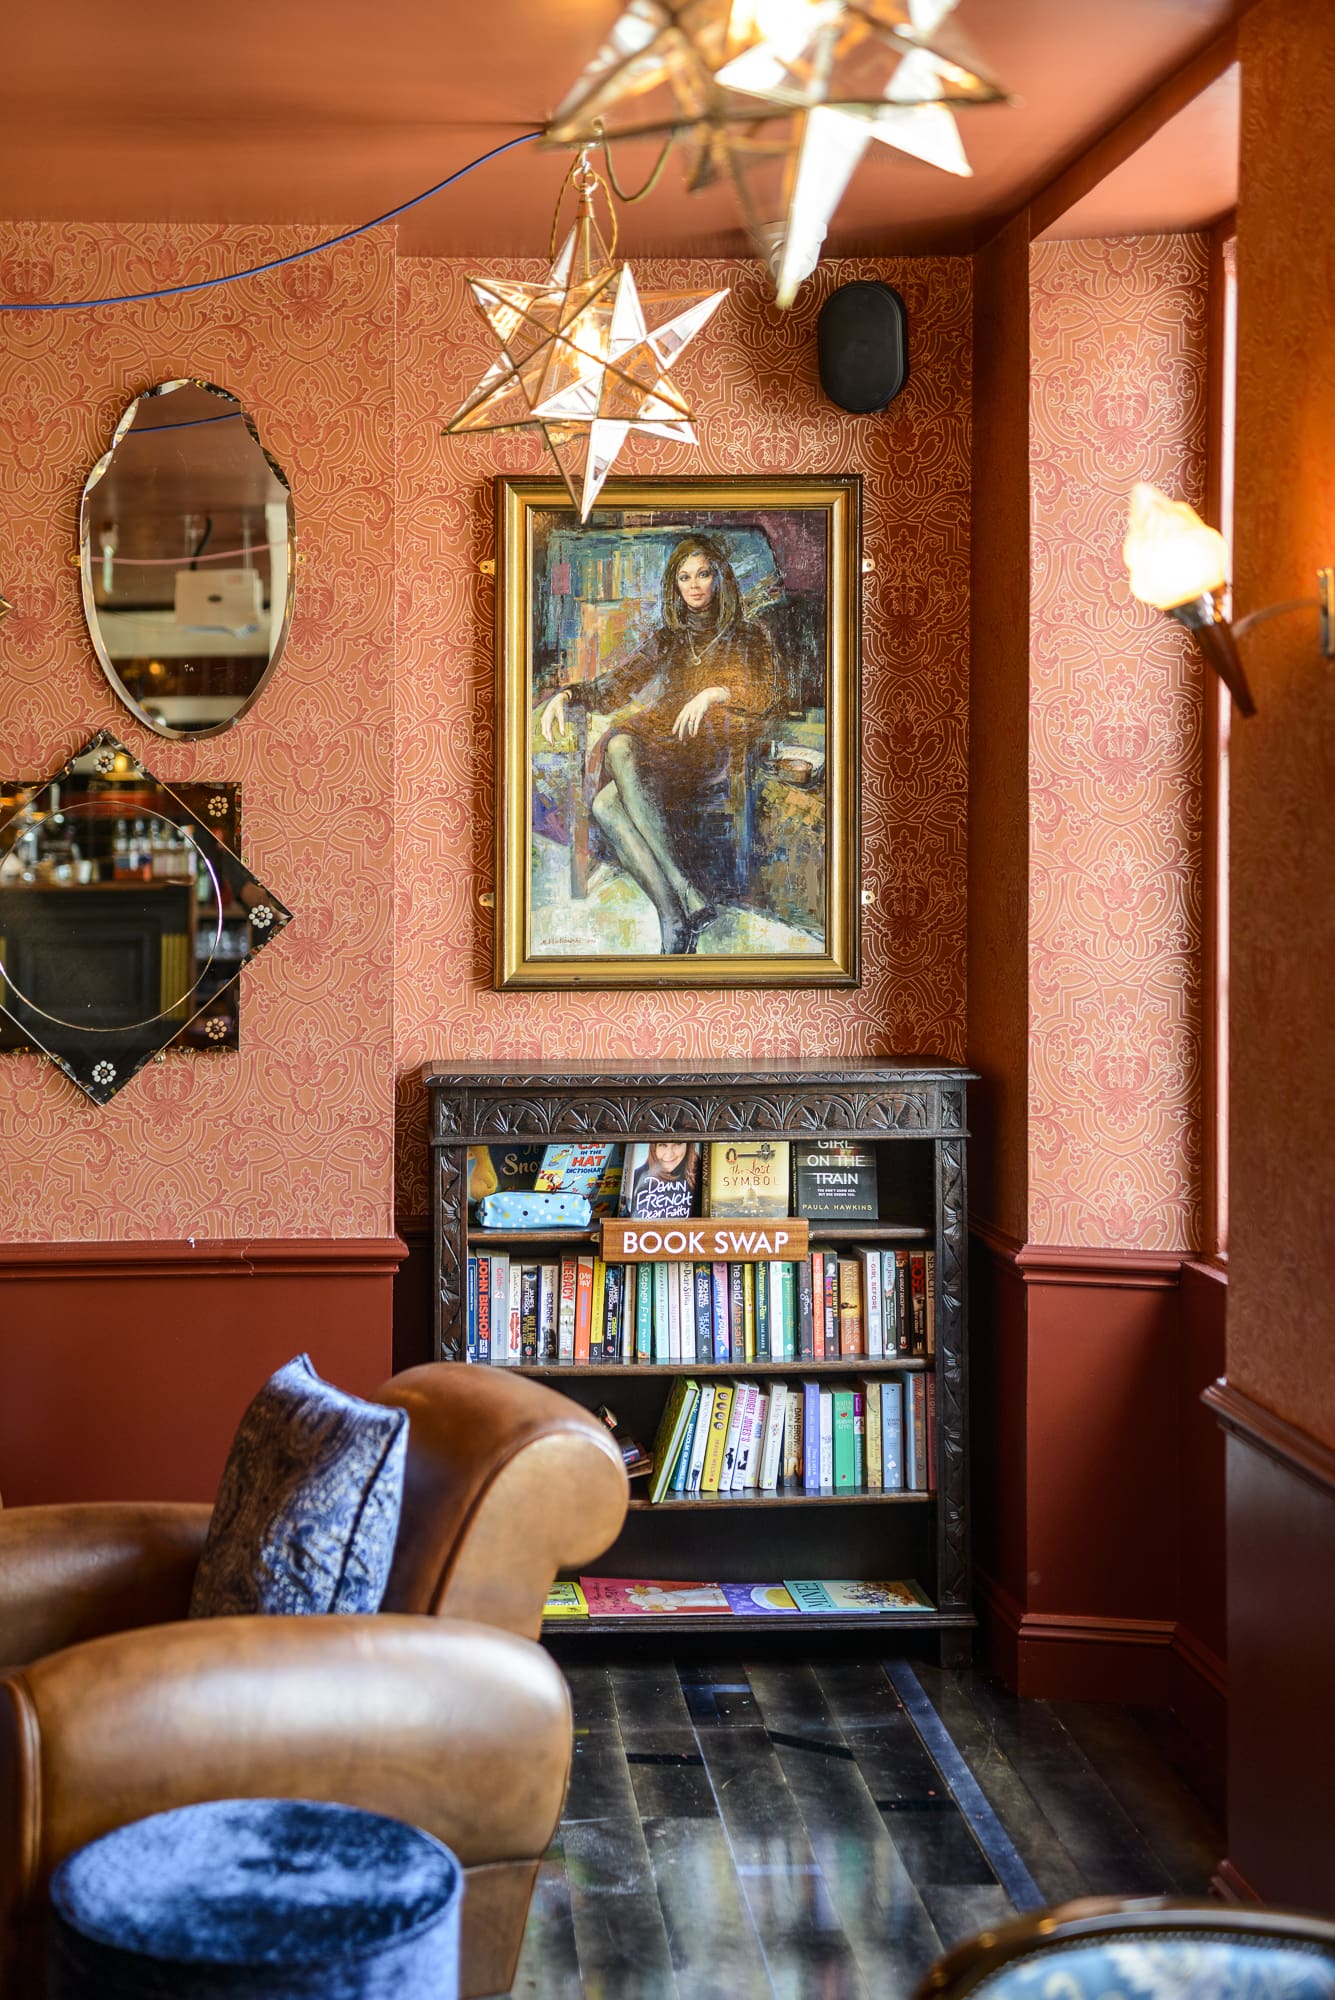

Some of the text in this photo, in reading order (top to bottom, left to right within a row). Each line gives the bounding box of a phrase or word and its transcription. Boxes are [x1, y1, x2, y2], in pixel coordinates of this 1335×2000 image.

[817, 1140, 854, 1149] GIRL
[502, 1153, 540, 1175] Sno
[571, 1156, 606, 1167] HAT
[747, 1159, 772, 1176] Lost
[807, 1154, 867, 1167] ON THE
[723, 1176, 778, 1187] SYMBOL
[814, 1172, 859, 1185] TRAIN
[636, 1190, 693, 1211] FRENCH
[623, 1231, 789, 1254] BOOK SWAP
[928, 1256, 936, 1272] SEX
[478, 1258, 489, 1292] JOHN
[562, 1261, 576, 1301] LEGACY
[640, 1266, 650, 1304] Stephen
[478, 1294, 490, 1338] BISHOP
[640, 1306, 650, 1323] Fry
[528, 1315, 536, 1344] KILL ME
[734, 1326, 744, 1346] said
[746, 1390, 758, 1415] BRIDGET
